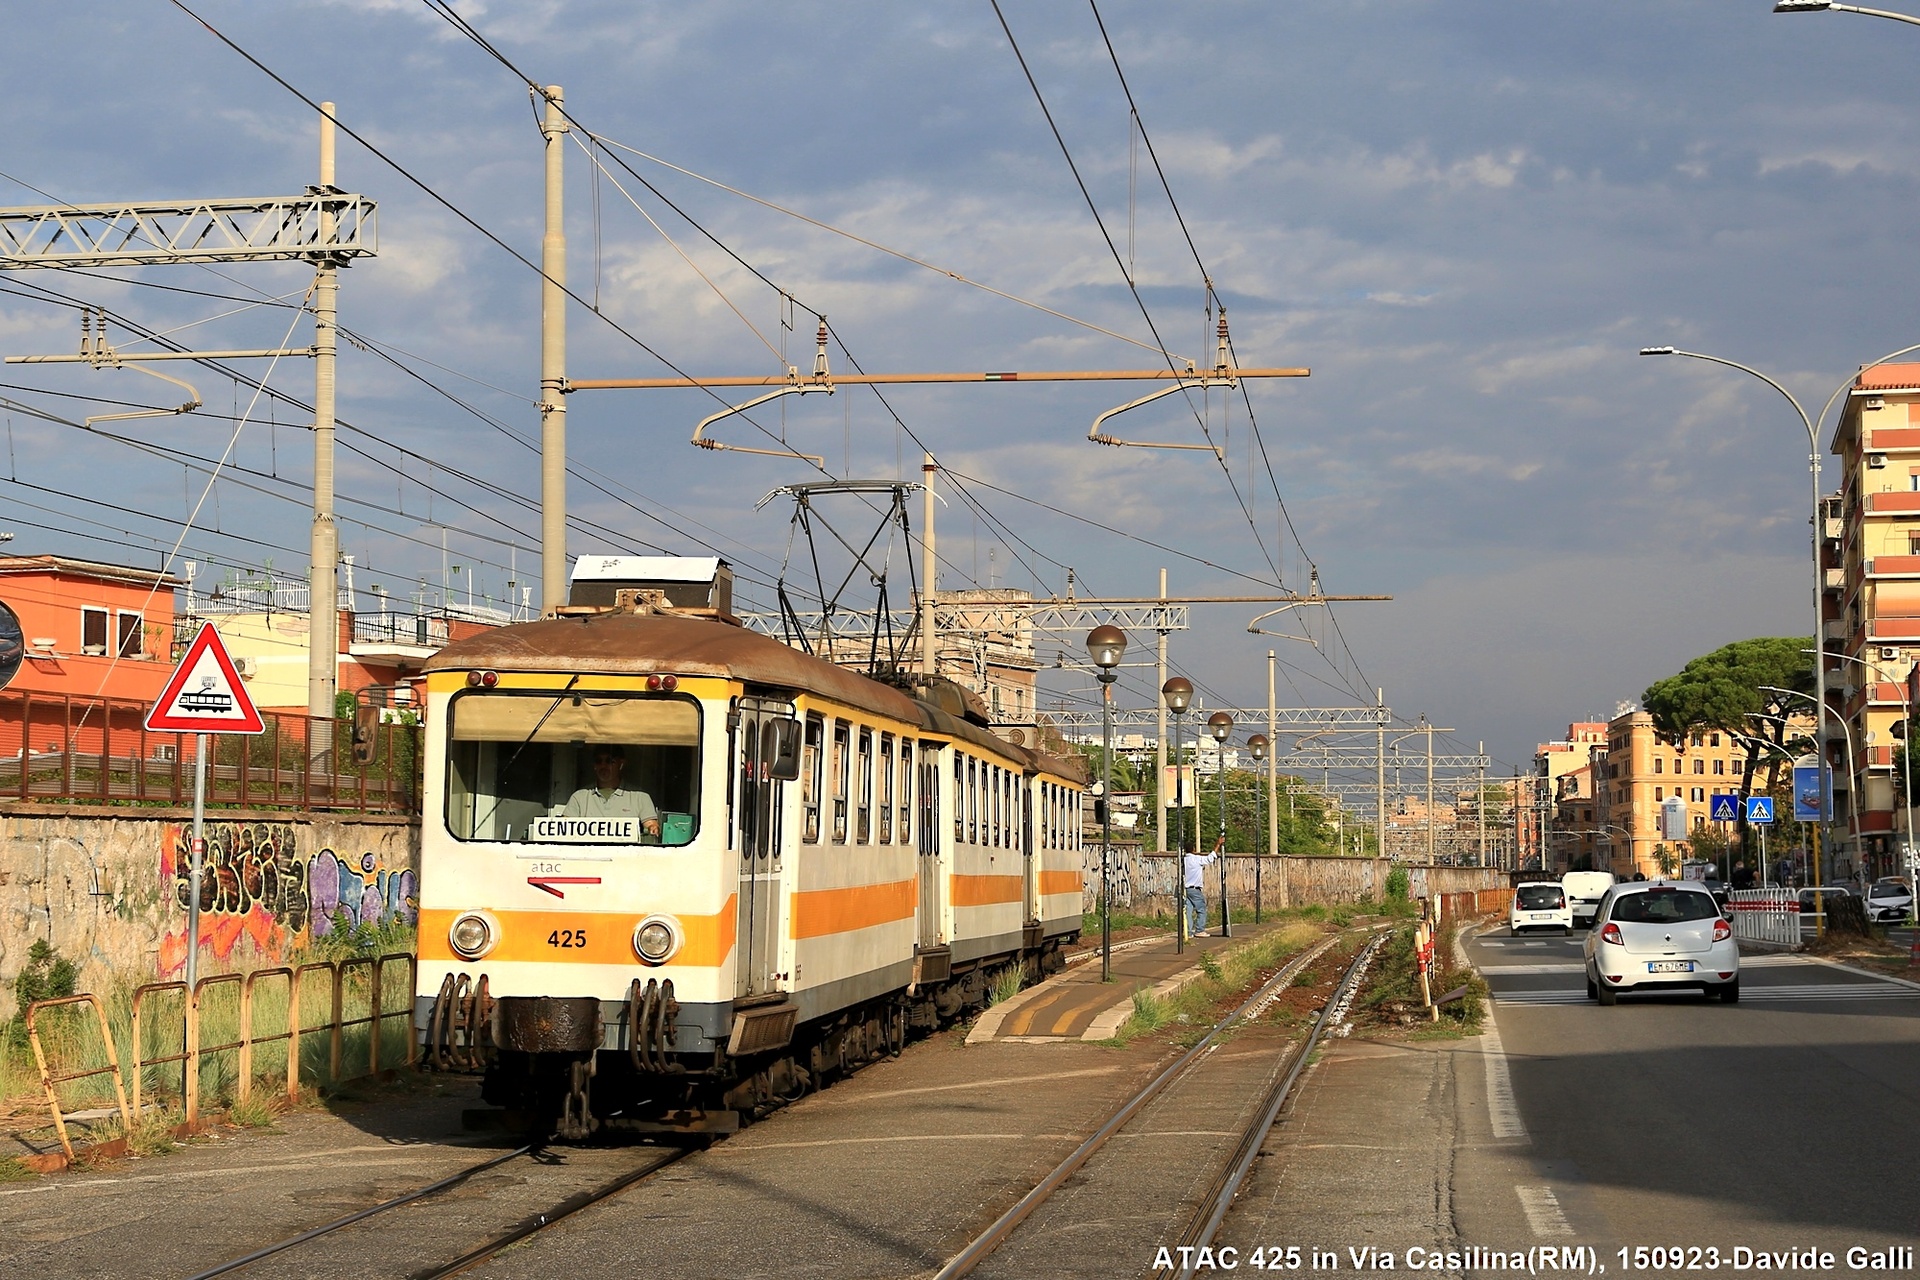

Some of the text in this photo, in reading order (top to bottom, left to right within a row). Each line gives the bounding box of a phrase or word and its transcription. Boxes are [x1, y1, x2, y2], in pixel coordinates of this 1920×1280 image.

[538, 821, 632, 837] CENTOCELLE
[531, 862, 562, 873] atac
[547, 929, 587, 948] 425
